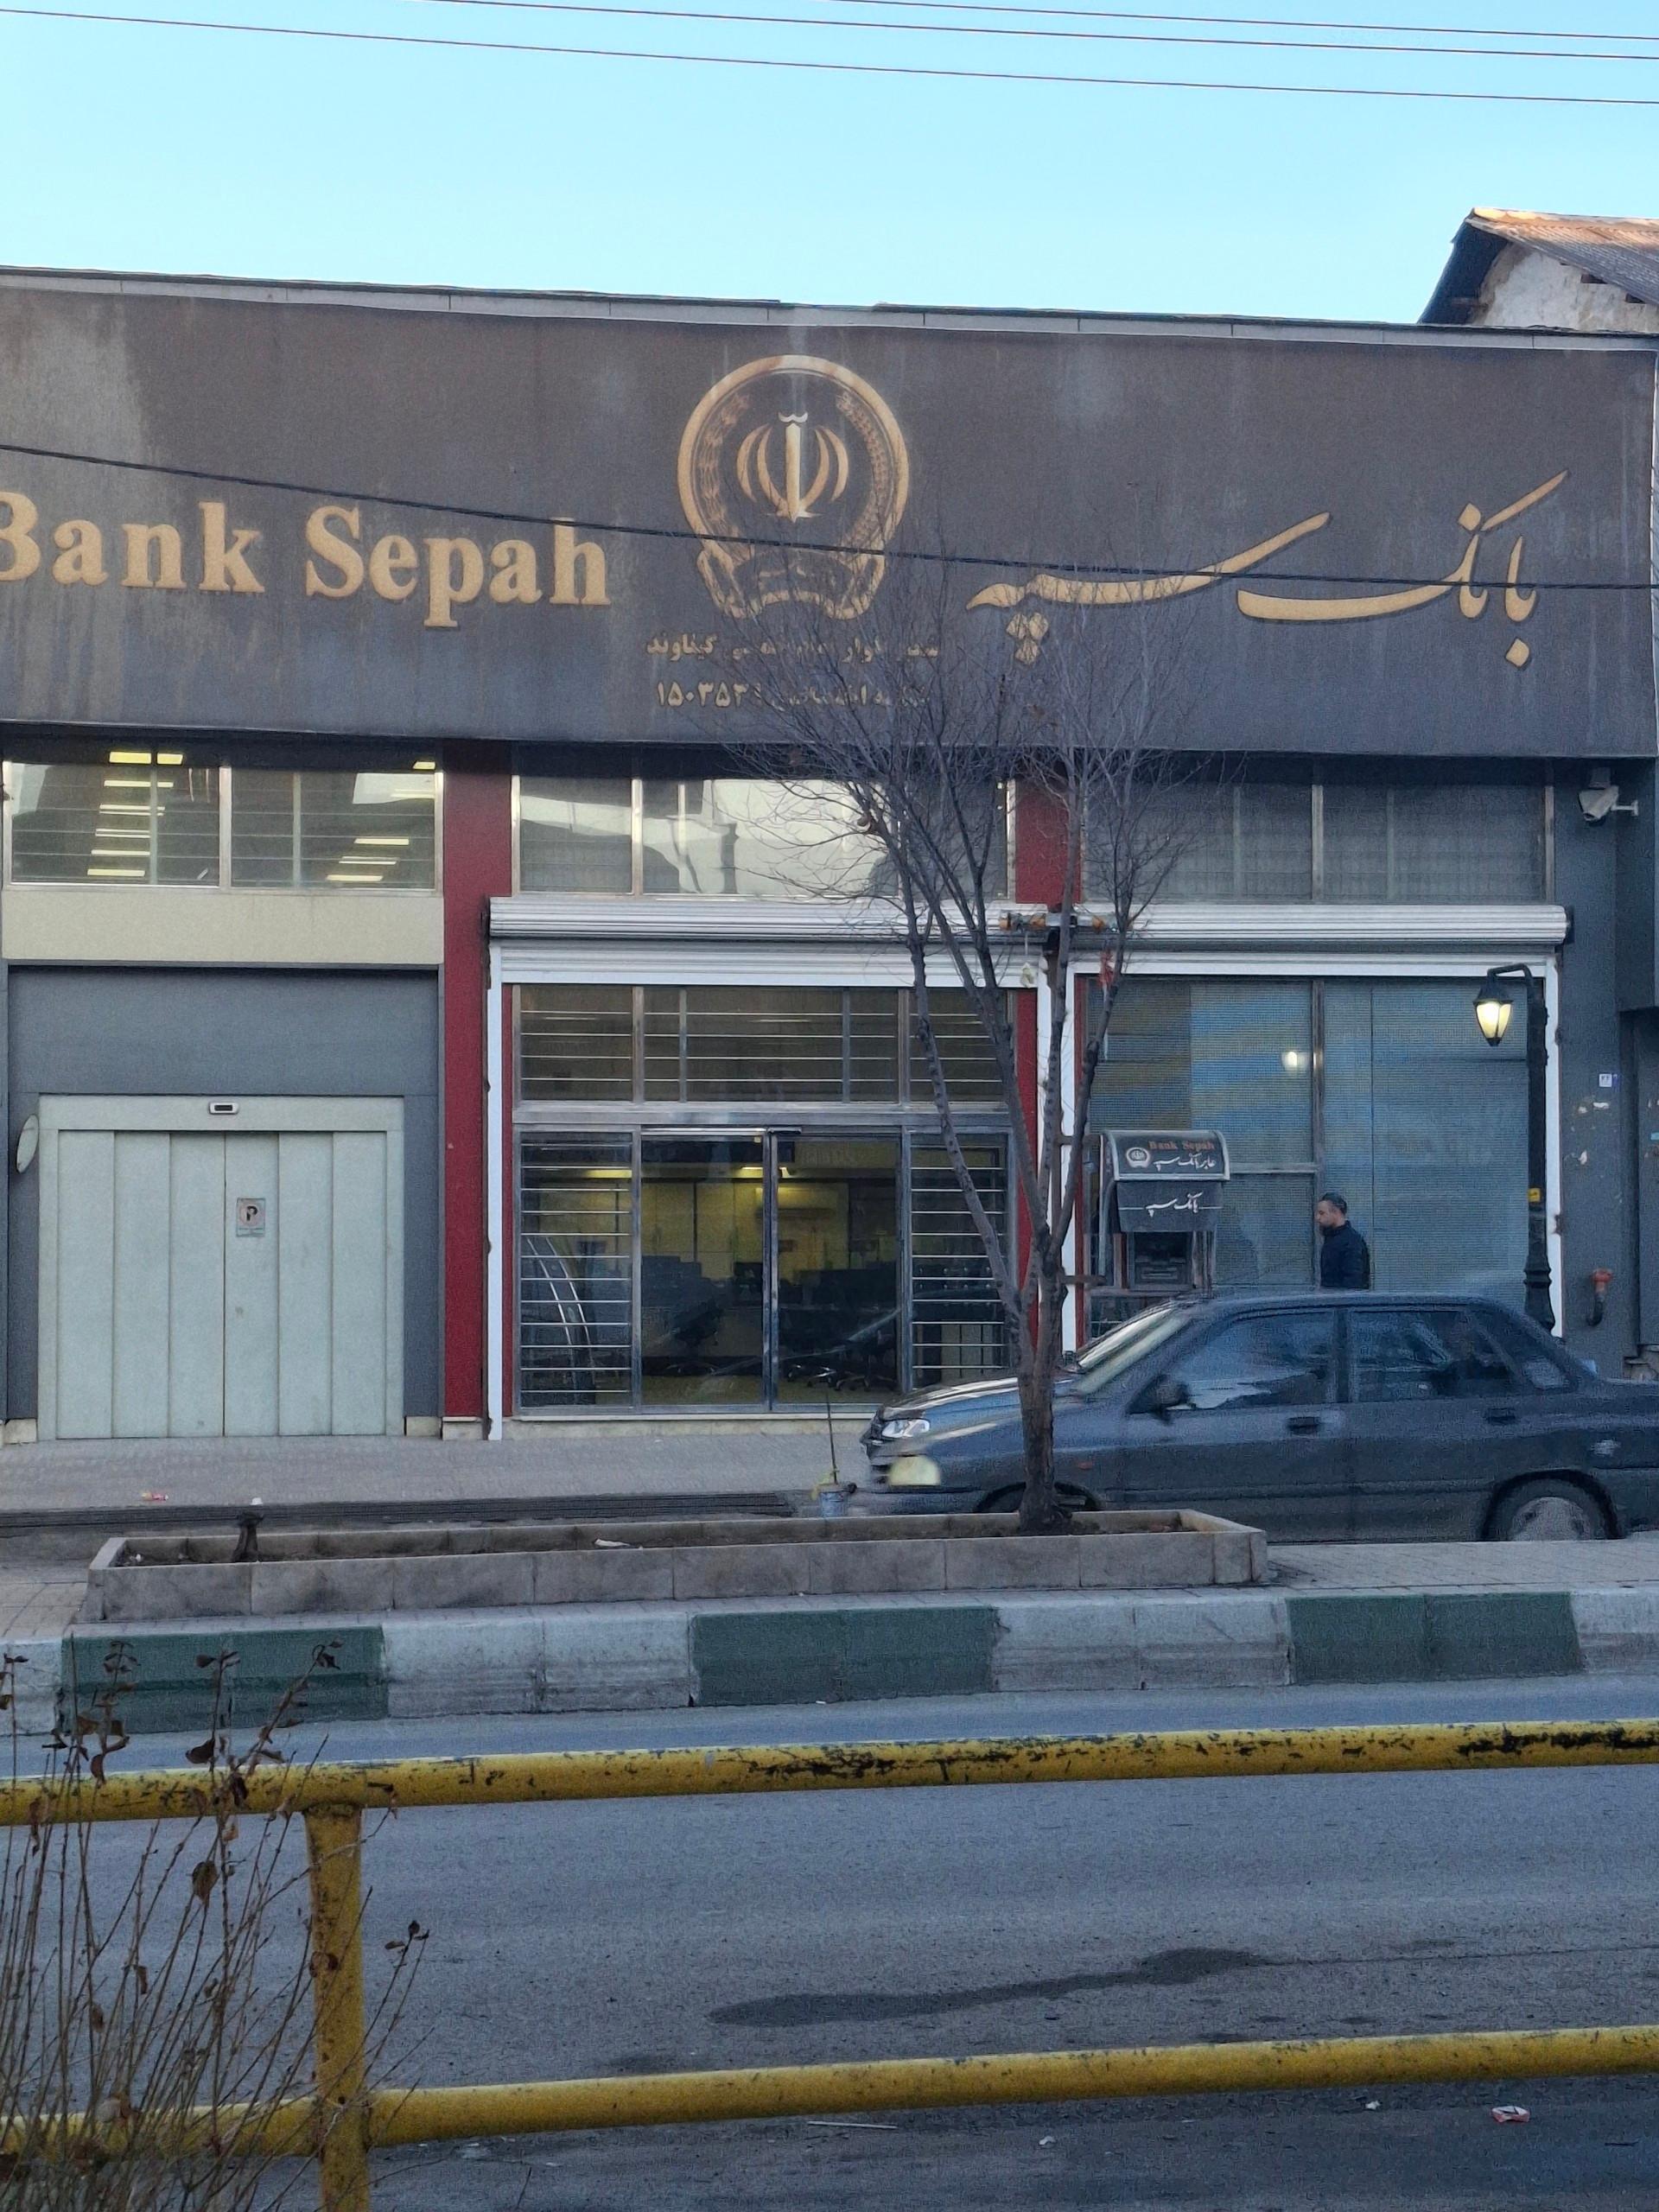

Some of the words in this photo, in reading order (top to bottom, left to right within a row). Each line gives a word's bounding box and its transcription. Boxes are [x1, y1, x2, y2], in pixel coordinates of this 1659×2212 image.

[0, 492, 265, 594] Bank
[305, 505, 612, 628] Sepah
[966, 512, 1330, 664] سپه
[1237, 469, 1568, 667] بانک
[246, 1205, 258, 1221] P
